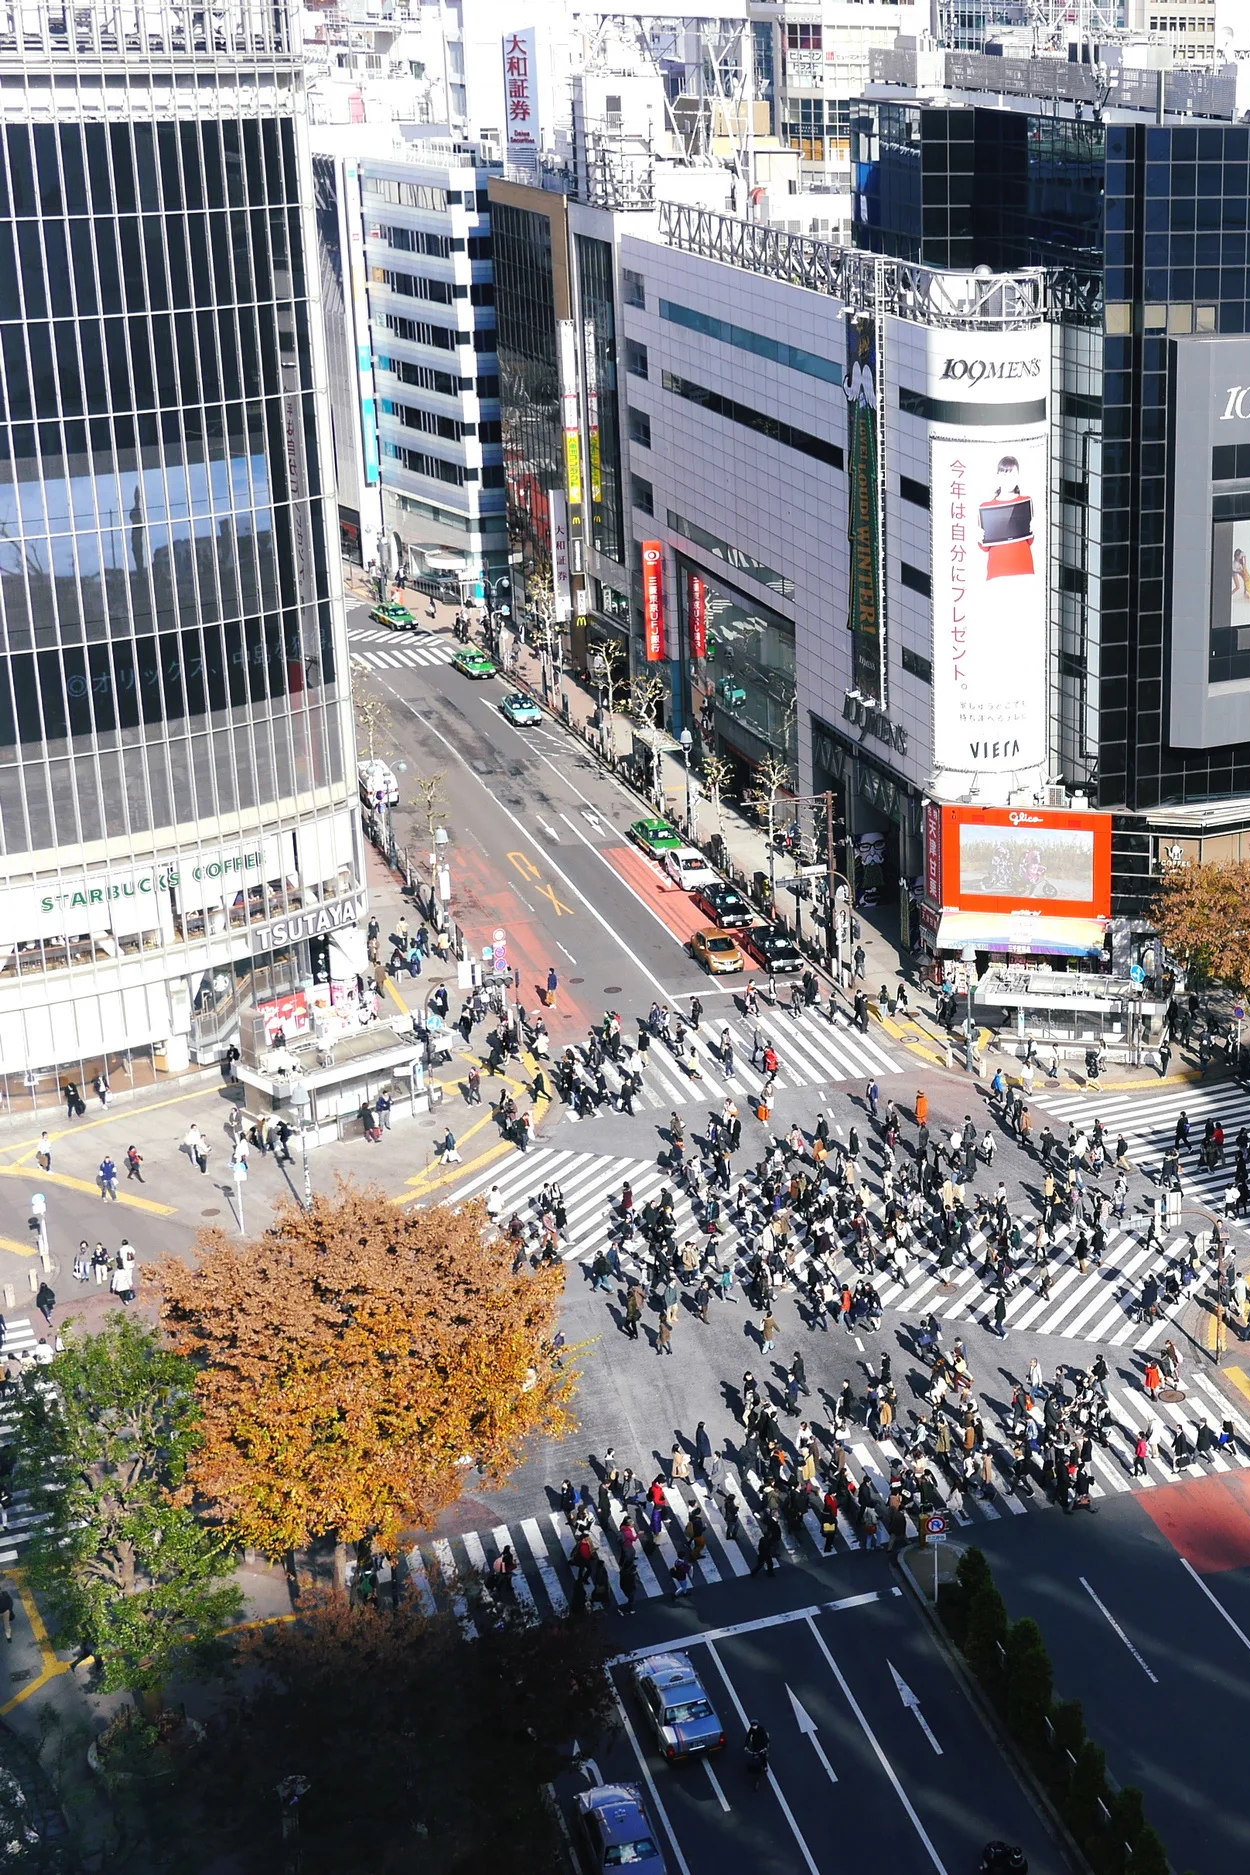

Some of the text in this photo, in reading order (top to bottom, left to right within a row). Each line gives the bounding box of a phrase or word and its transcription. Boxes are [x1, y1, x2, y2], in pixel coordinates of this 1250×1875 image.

[506, 34, 530, 121] 大和証券
[555, 525, 568, 581] 大和証券
[855, 523, 877, 634] WINTER!
[949, 459, 968, 690] 今年は自分にプレゼント。
[40, 850, 267, 913] STARBUCKS COFFEE
[256, 899, 357, 951] TSUTAYA
